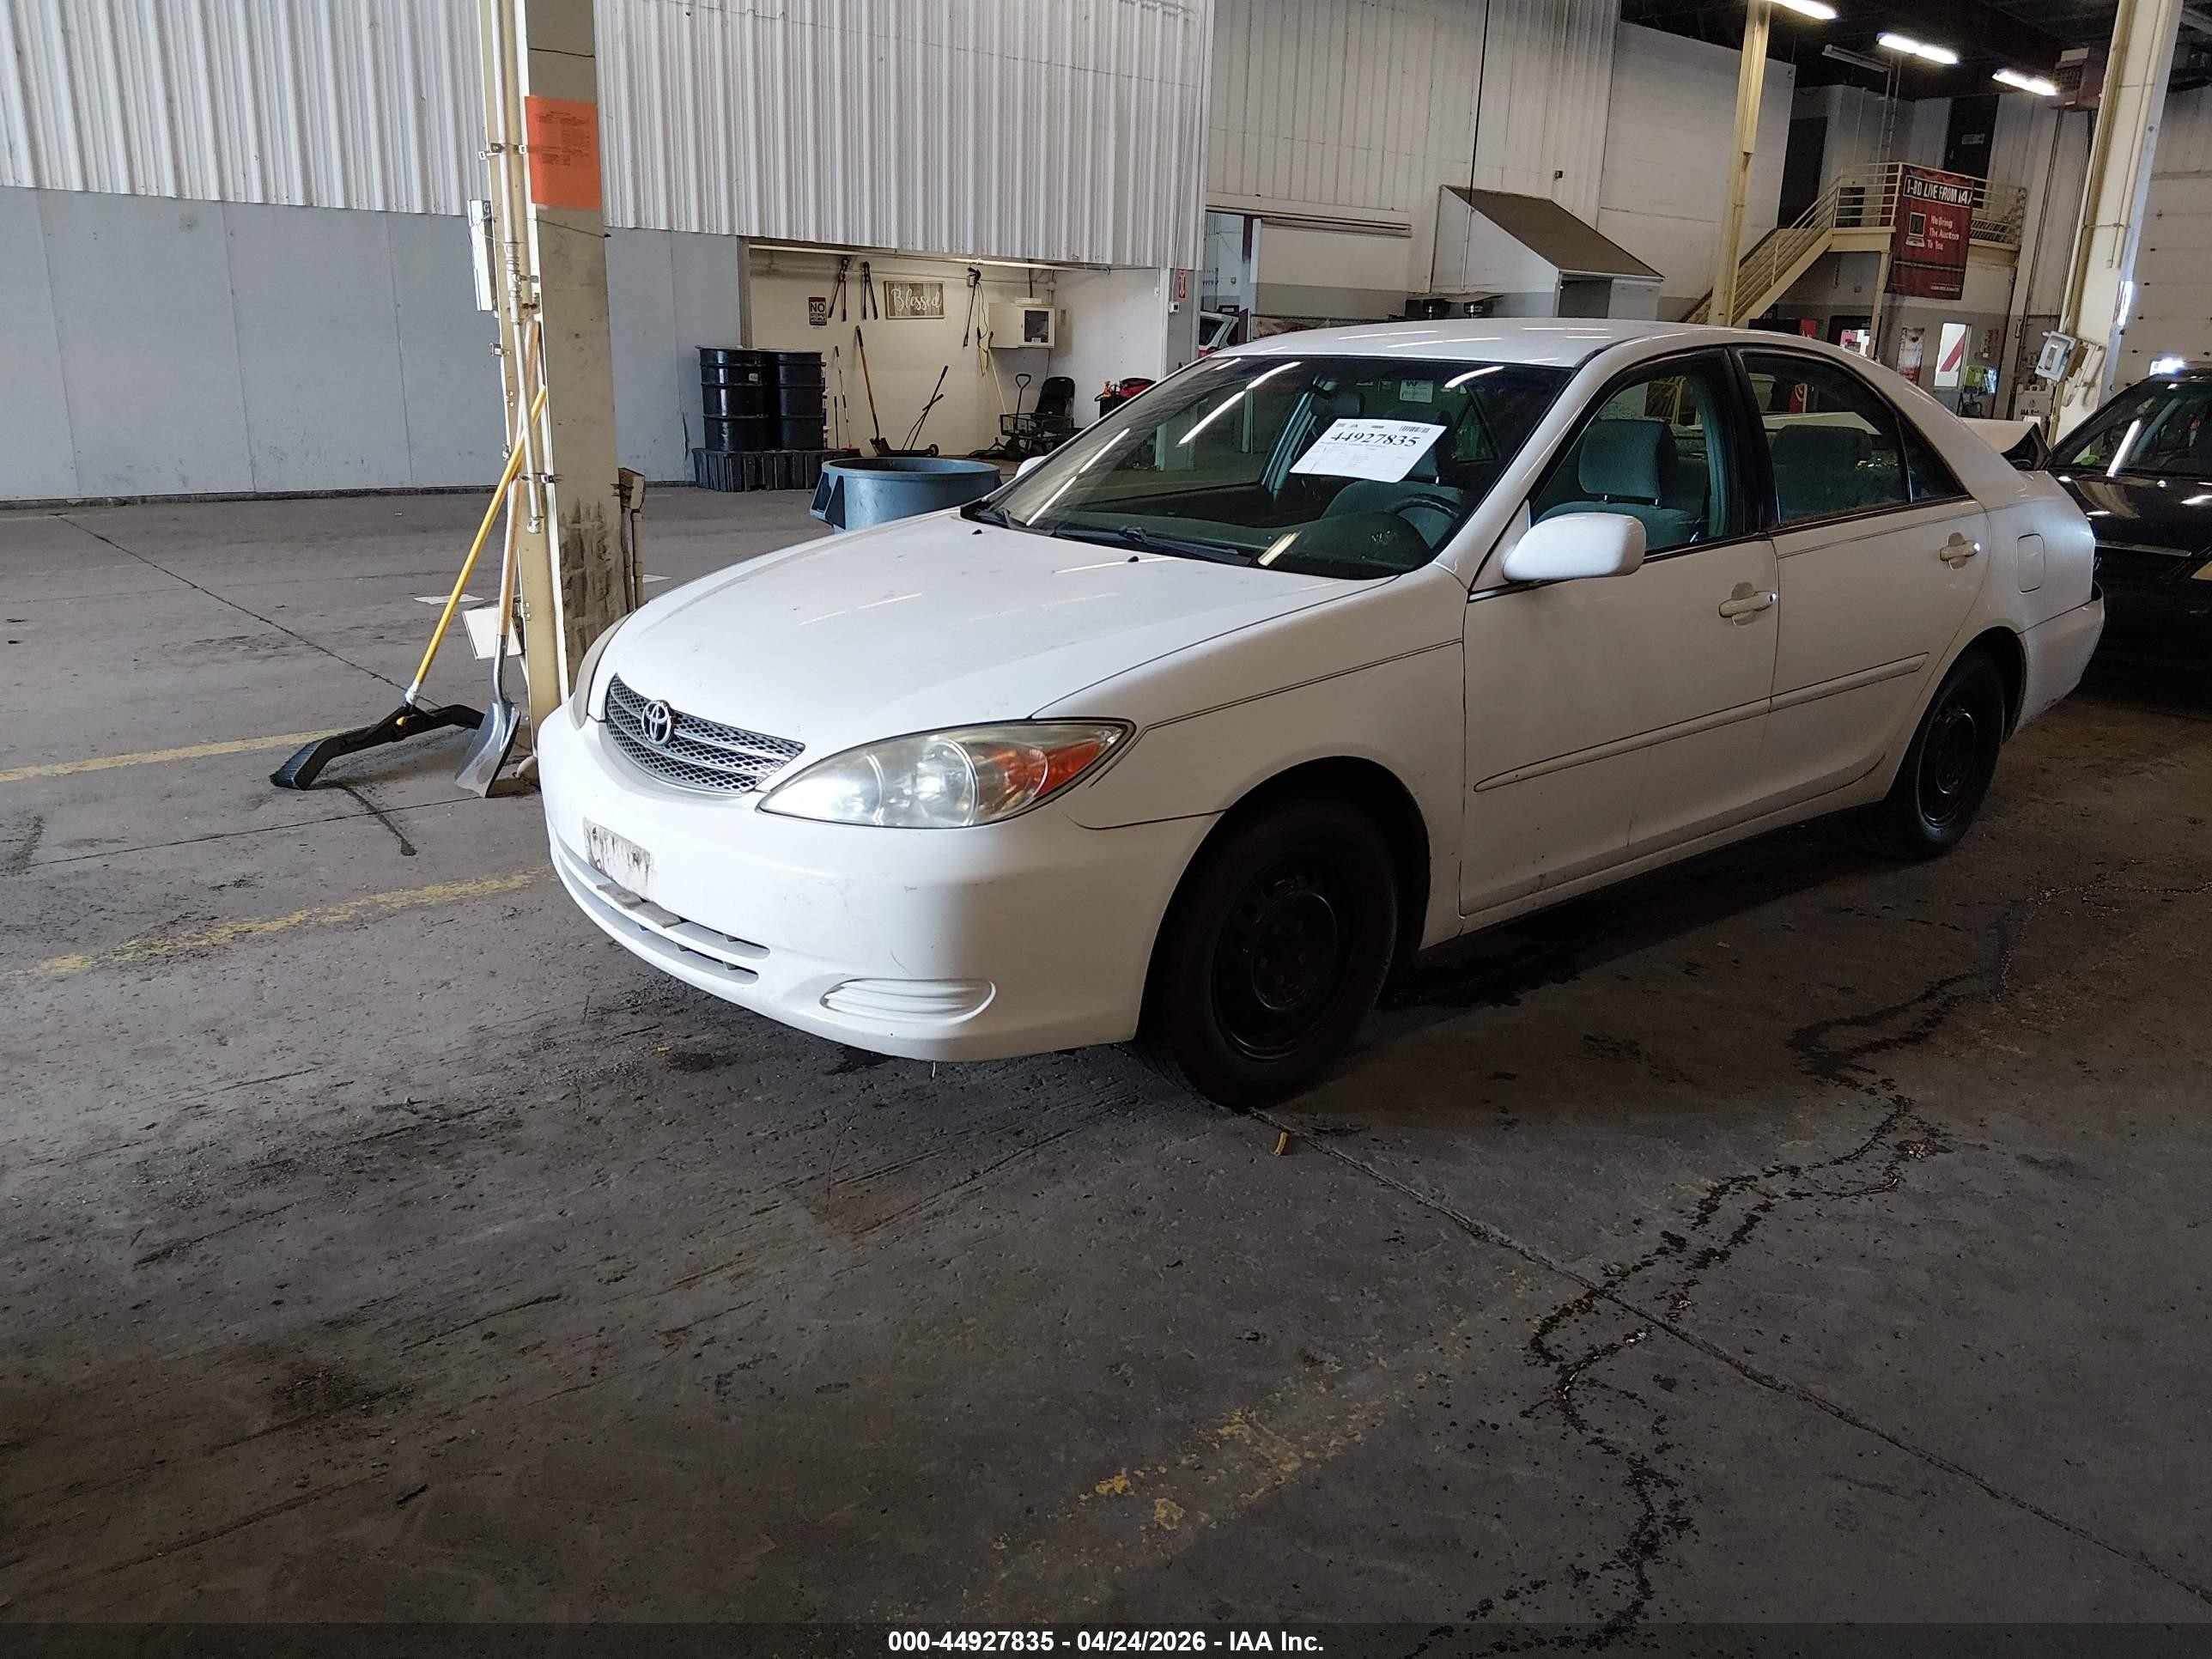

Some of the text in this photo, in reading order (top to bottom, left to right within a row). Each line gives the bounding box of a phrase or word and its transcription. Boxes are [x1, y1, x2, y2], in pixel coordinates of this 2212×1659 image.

[1939, 186, 1958, 203] FROM
[810, 302, 825, 313] NO
[890, 288, 943, 311] Blessed
[1330, 431, 1422, 447] 44927835
